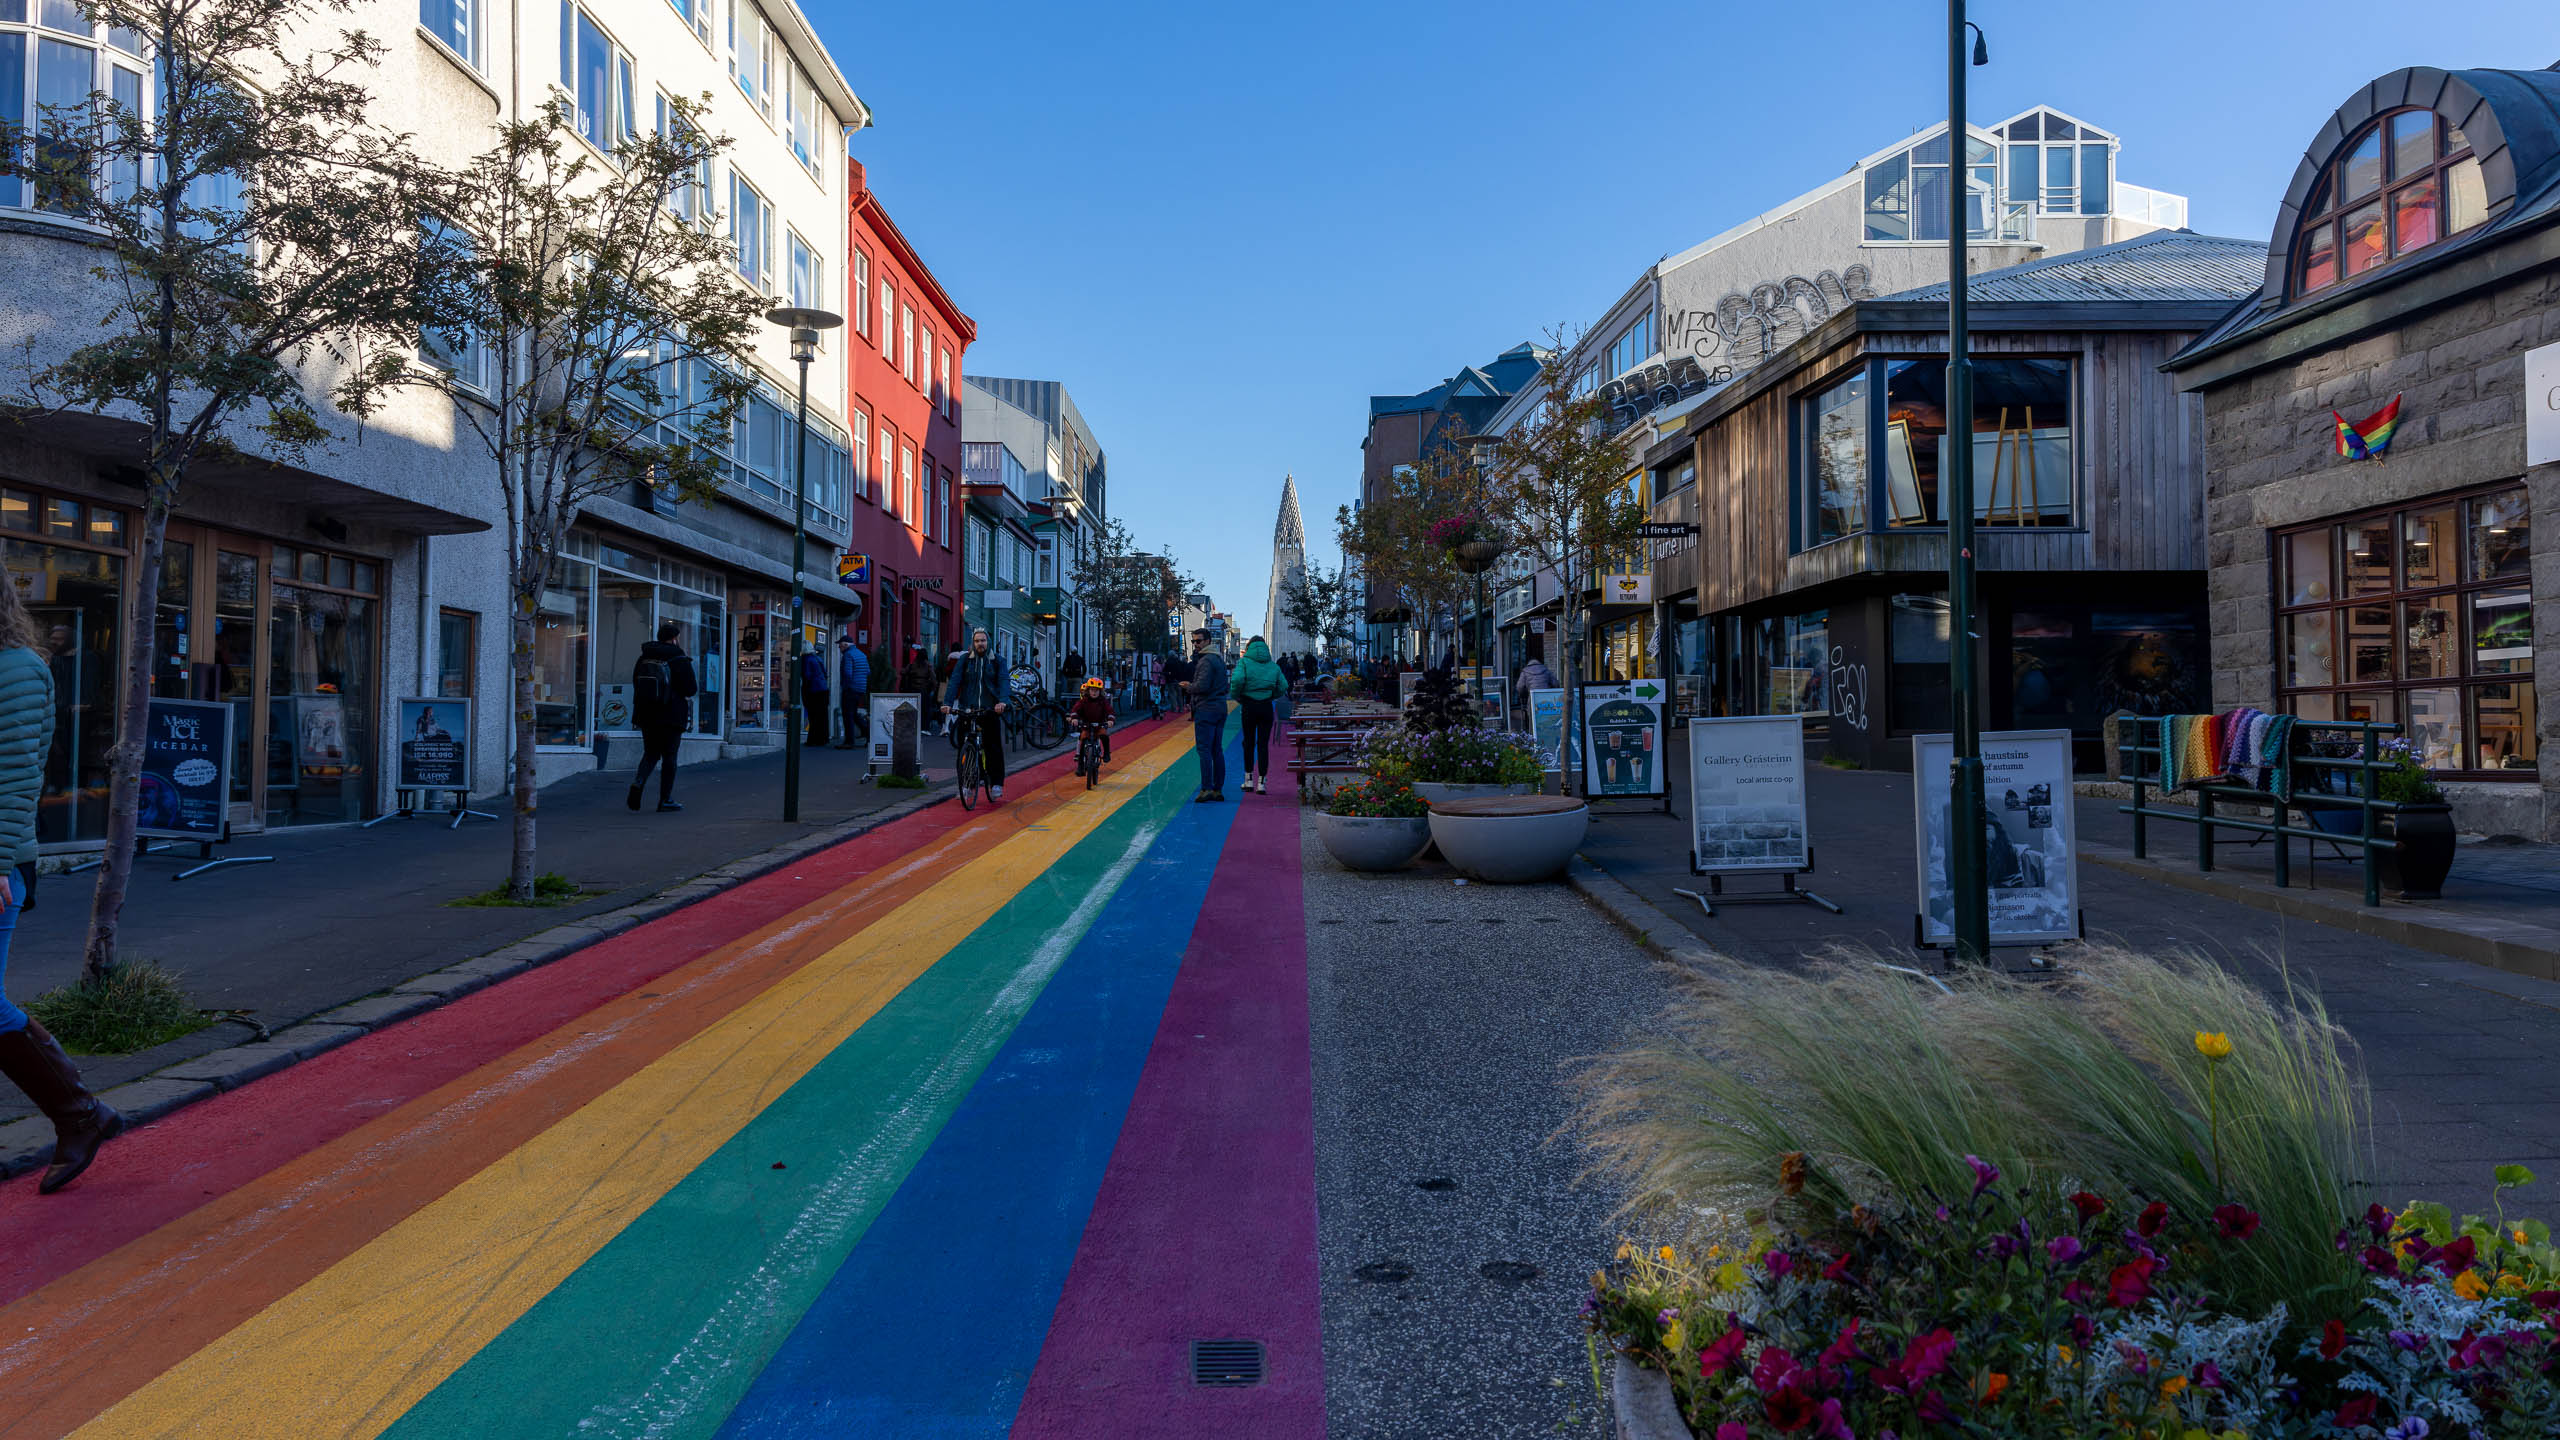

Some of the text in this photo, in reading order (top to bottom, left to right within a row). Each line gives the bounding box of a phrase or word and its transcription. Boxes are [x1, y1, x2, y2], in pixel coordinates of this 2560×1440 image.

[1650, 525, 1669, 534] fine
[1671, 526, 1685, 534] art
[843, 557, 863, 565] ATM
[906, 577, 943, 591] MOKKA
[170, 725, 200, 740] ICE
[152, 740, 209, 752] ICEBAR
[1704, 753, 1792, 767] Gallery Grásteinn
[1984, 751, 2029, 760] haustsins
[1983, 763, 1992, 771] of
[1736, 776, 1793, 785] Local artist co-op
[1983, 775, 2011, 784] ibition
